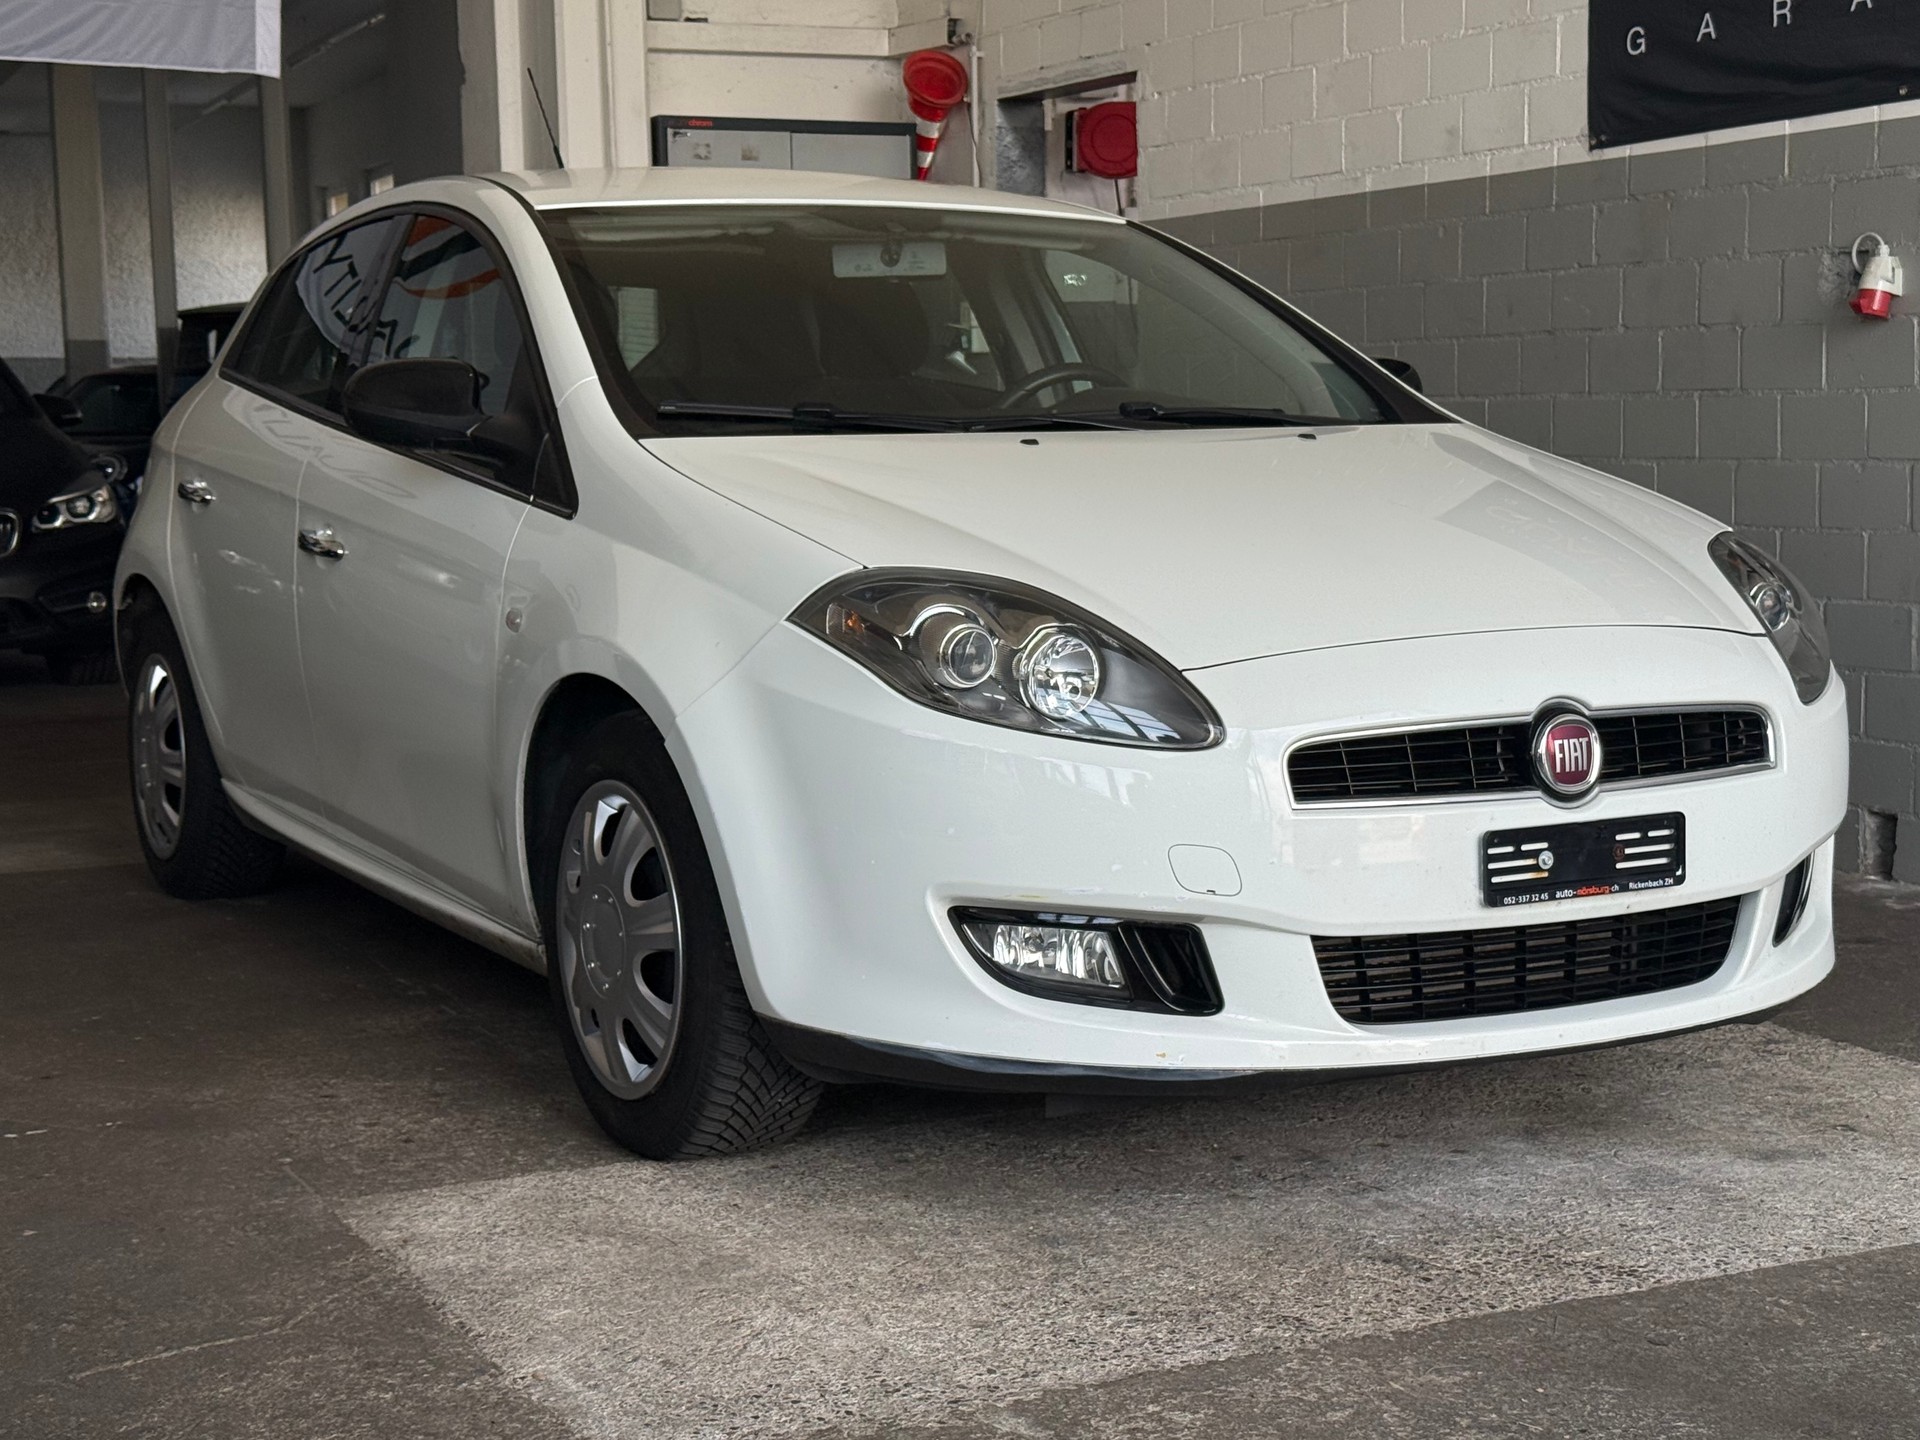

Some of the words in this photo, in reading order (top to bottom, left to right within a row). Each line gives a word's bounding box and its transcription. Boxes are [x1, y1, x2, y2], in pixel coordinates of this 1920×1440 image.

[1553, 737, 1589, 773] FIAT
[1531, 893, 1540, 902] 32
[1540, 892, 1549, 901] 45
[1629, 879, 1663, 890] Rickenbach
[1664, 877, 1674, 886] ZH
